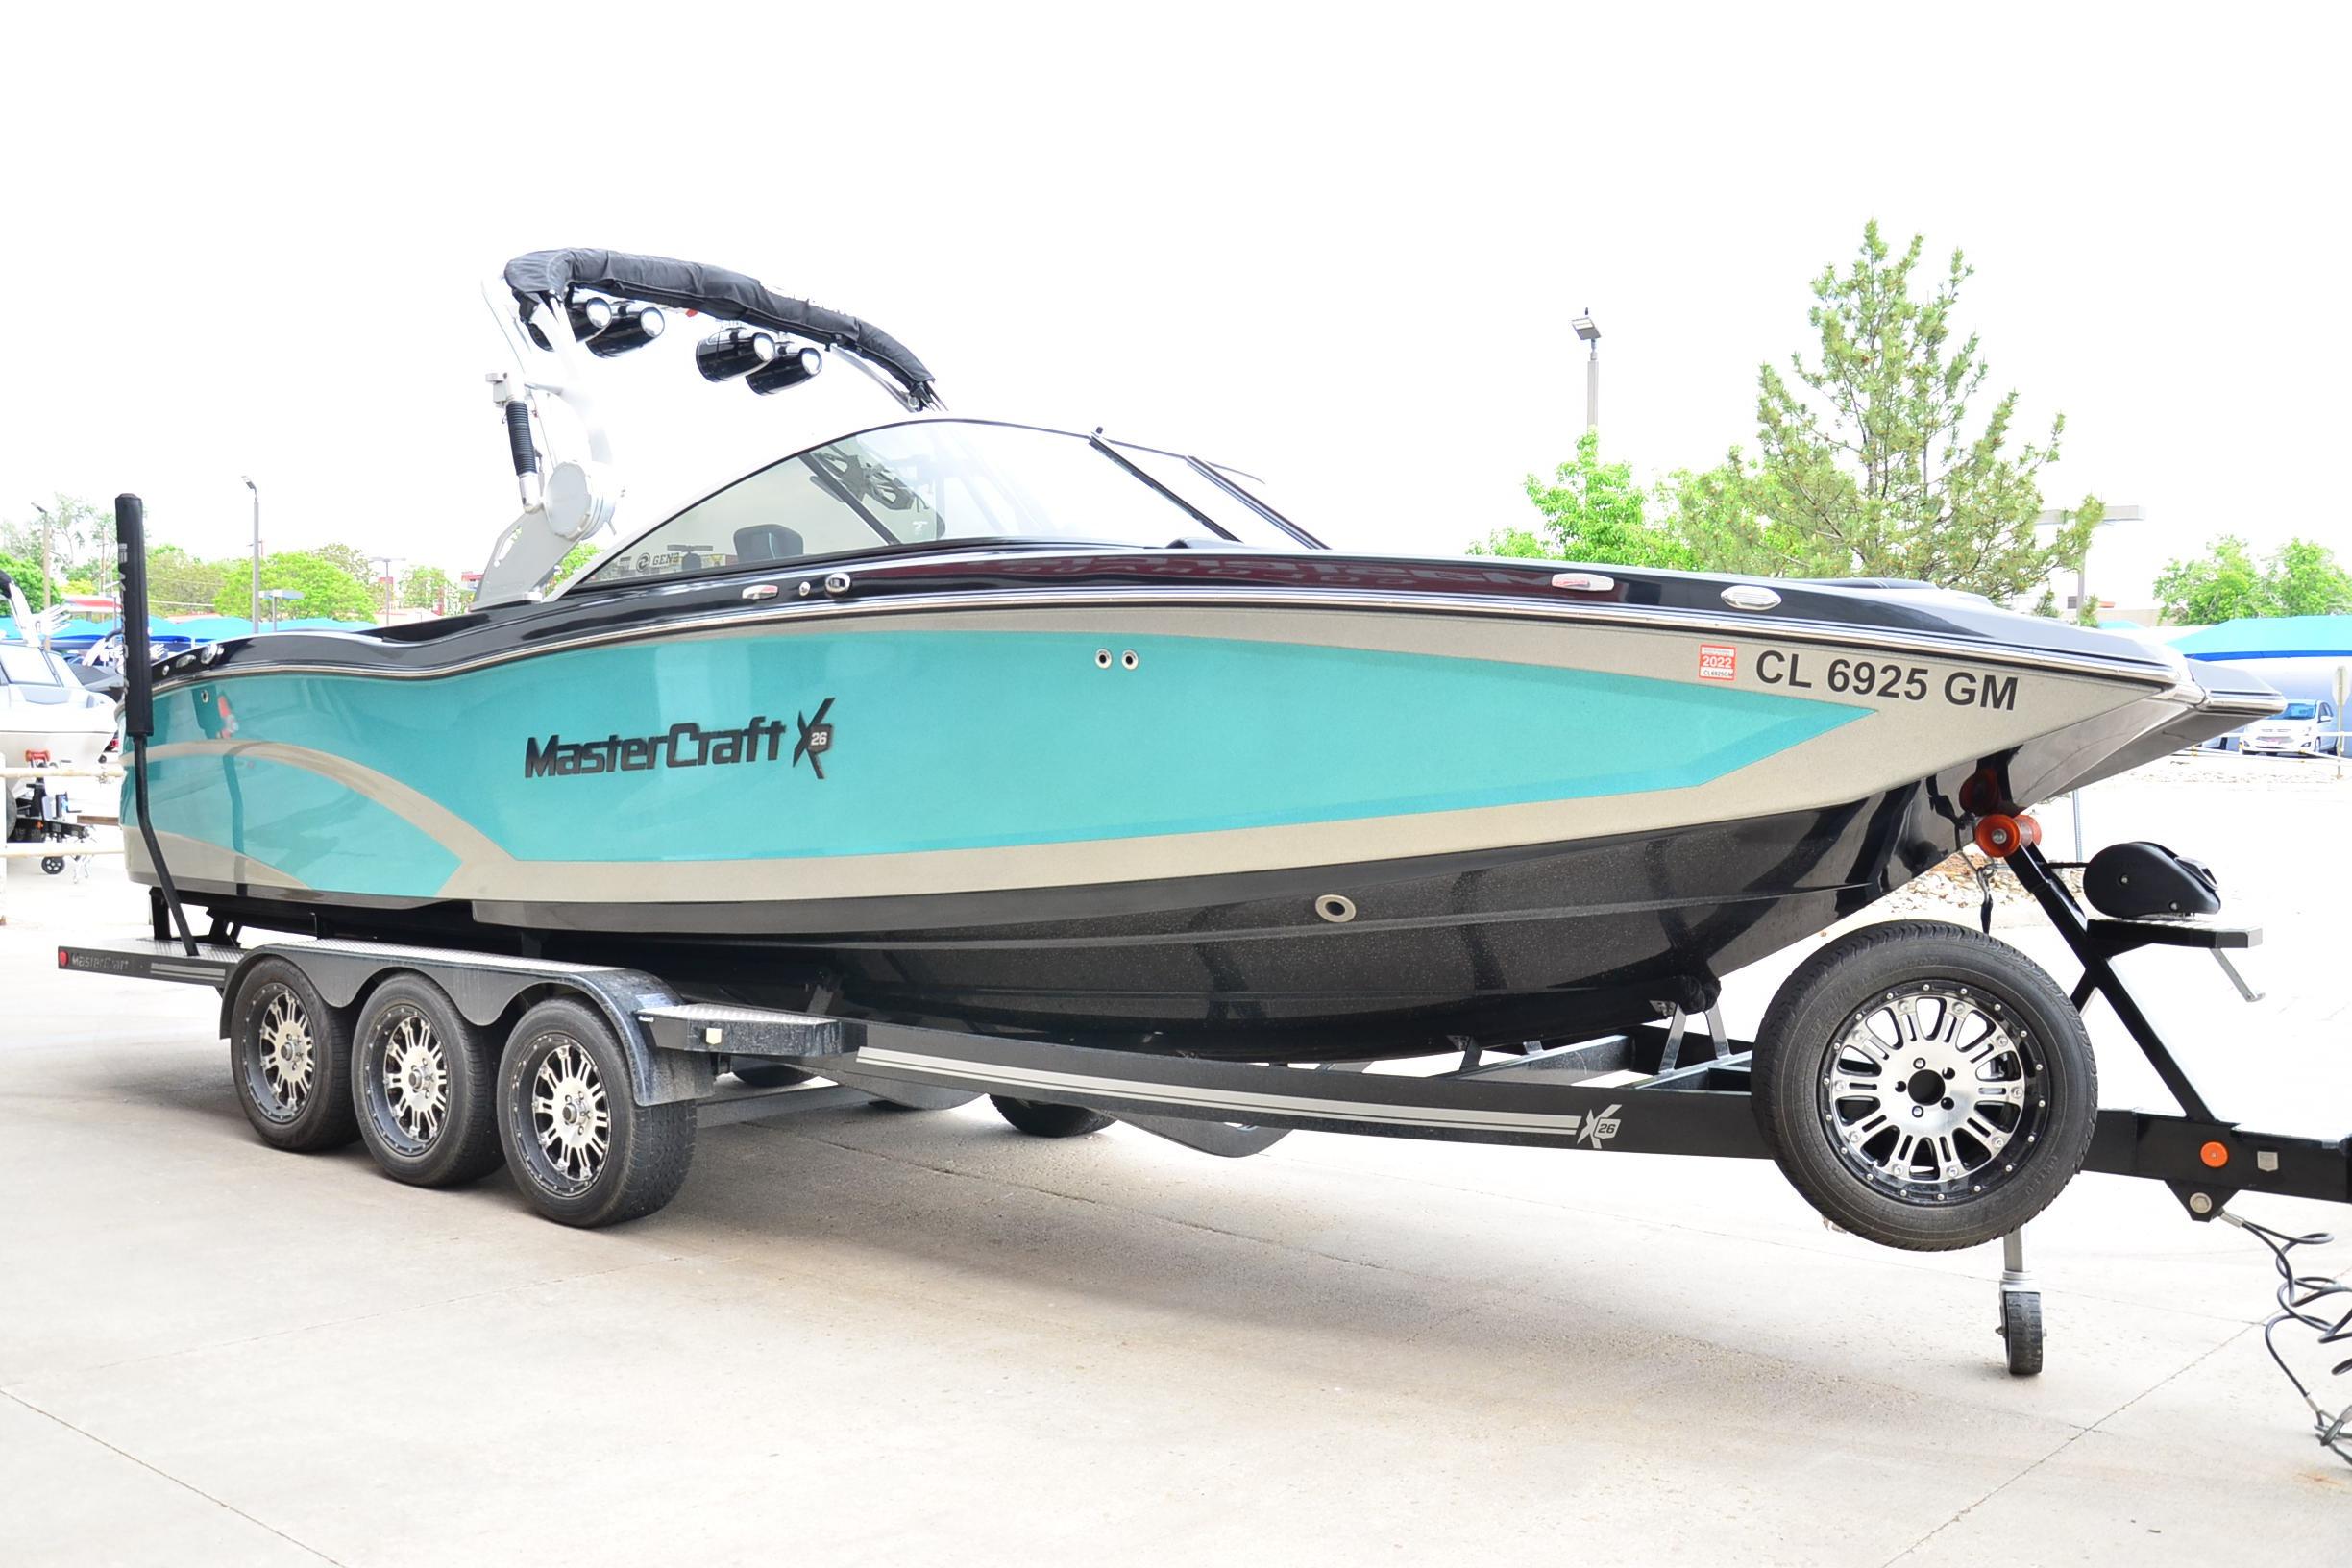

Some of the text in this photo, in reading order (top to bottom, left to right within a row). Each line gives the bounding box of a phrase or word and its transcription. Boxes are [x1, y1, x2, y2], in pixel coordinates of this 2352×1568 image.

[1702, 655, 1733, 669] 2022
[1756, 650, 2019, 711] CL 6925 GM
[525, 716, 787, 779] MasterCraft
